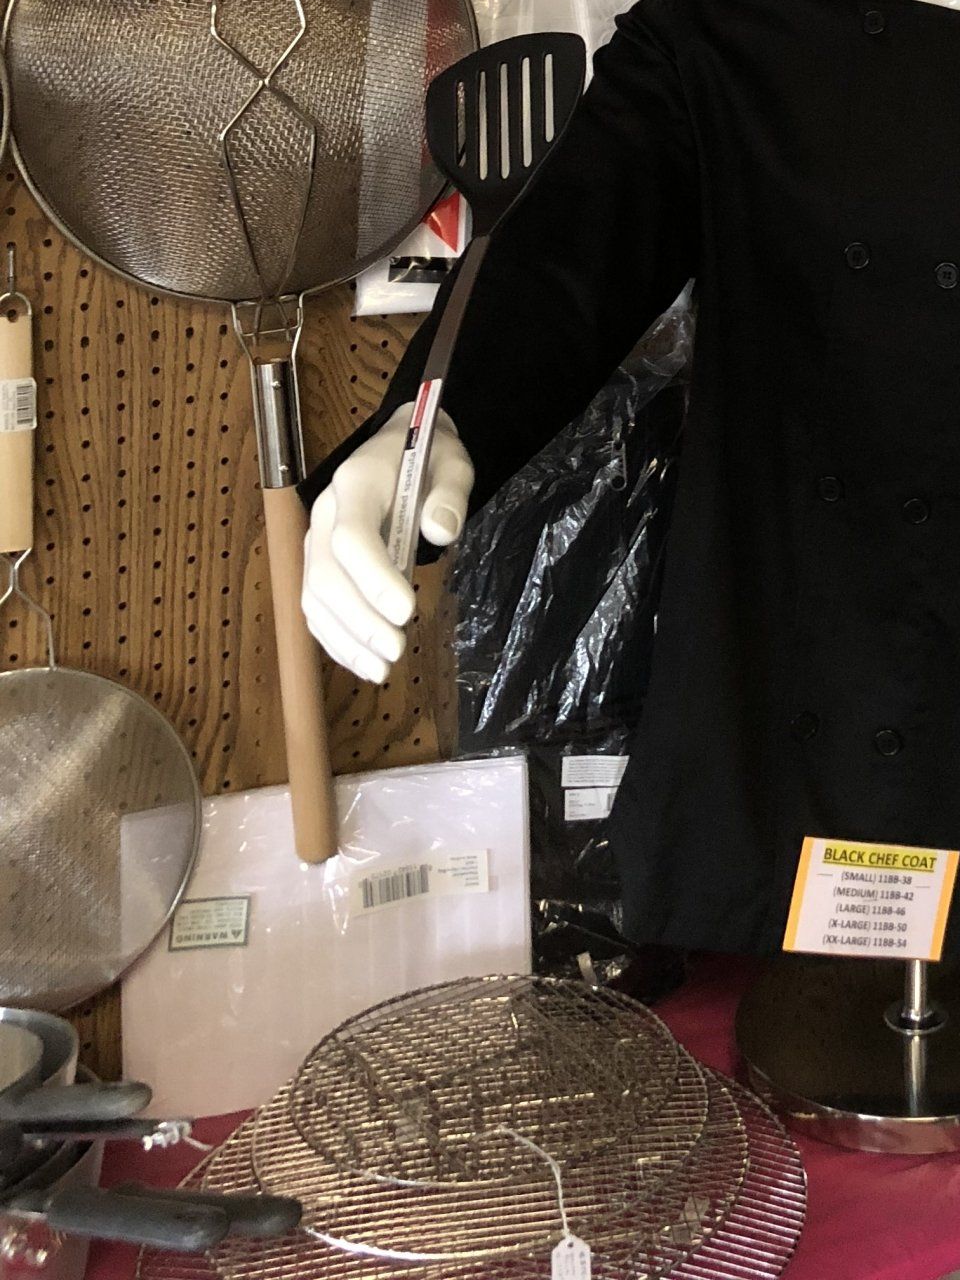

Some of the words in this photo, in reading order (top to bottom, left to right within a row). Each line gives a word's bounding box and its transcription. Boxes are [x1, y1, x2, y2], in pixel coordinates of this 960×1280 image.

[823, 847, 866, 863] BLACK
[868, 851, 900, 866] CHEF
[901, 854, 938, 869] COAT
[841, 870, 877, 886] (SMALL)
[833, 885, 879, 901] (MEDIUM)
[835, 901, 871, 916] (LARGE)
[828, 917, 871, 932] (X-LARGE)
[175, 931, 228, 943] WARNING
[822, 933, 871, 949] (XX-LARGE)
